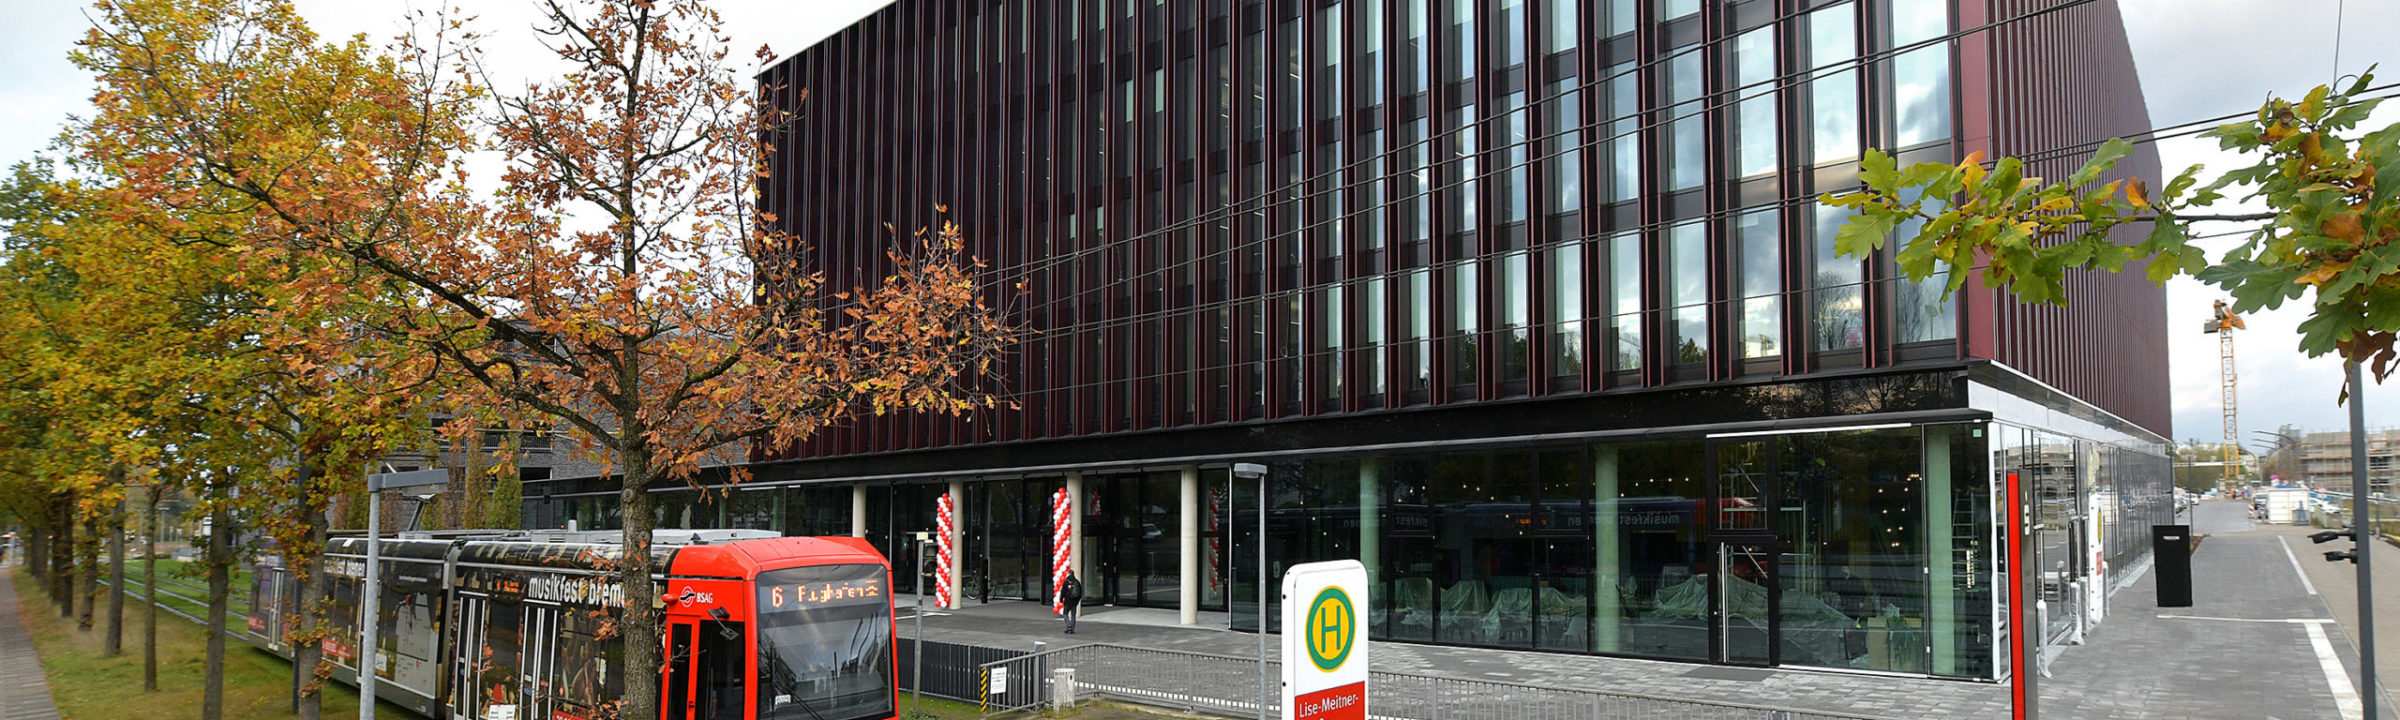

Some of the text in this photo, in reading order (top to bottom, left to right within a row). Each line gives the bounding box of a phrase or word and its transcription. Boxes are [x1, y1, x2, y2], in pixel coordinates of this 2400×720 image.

[528, 573, 583, 603] musikfest
[696, 592, 713, 604] BSAG
[772, 585, 784, 608] 6
[1321, 605, 1341, 653] H
[1299, 693, 1359, 718] Lise-Meitner-
